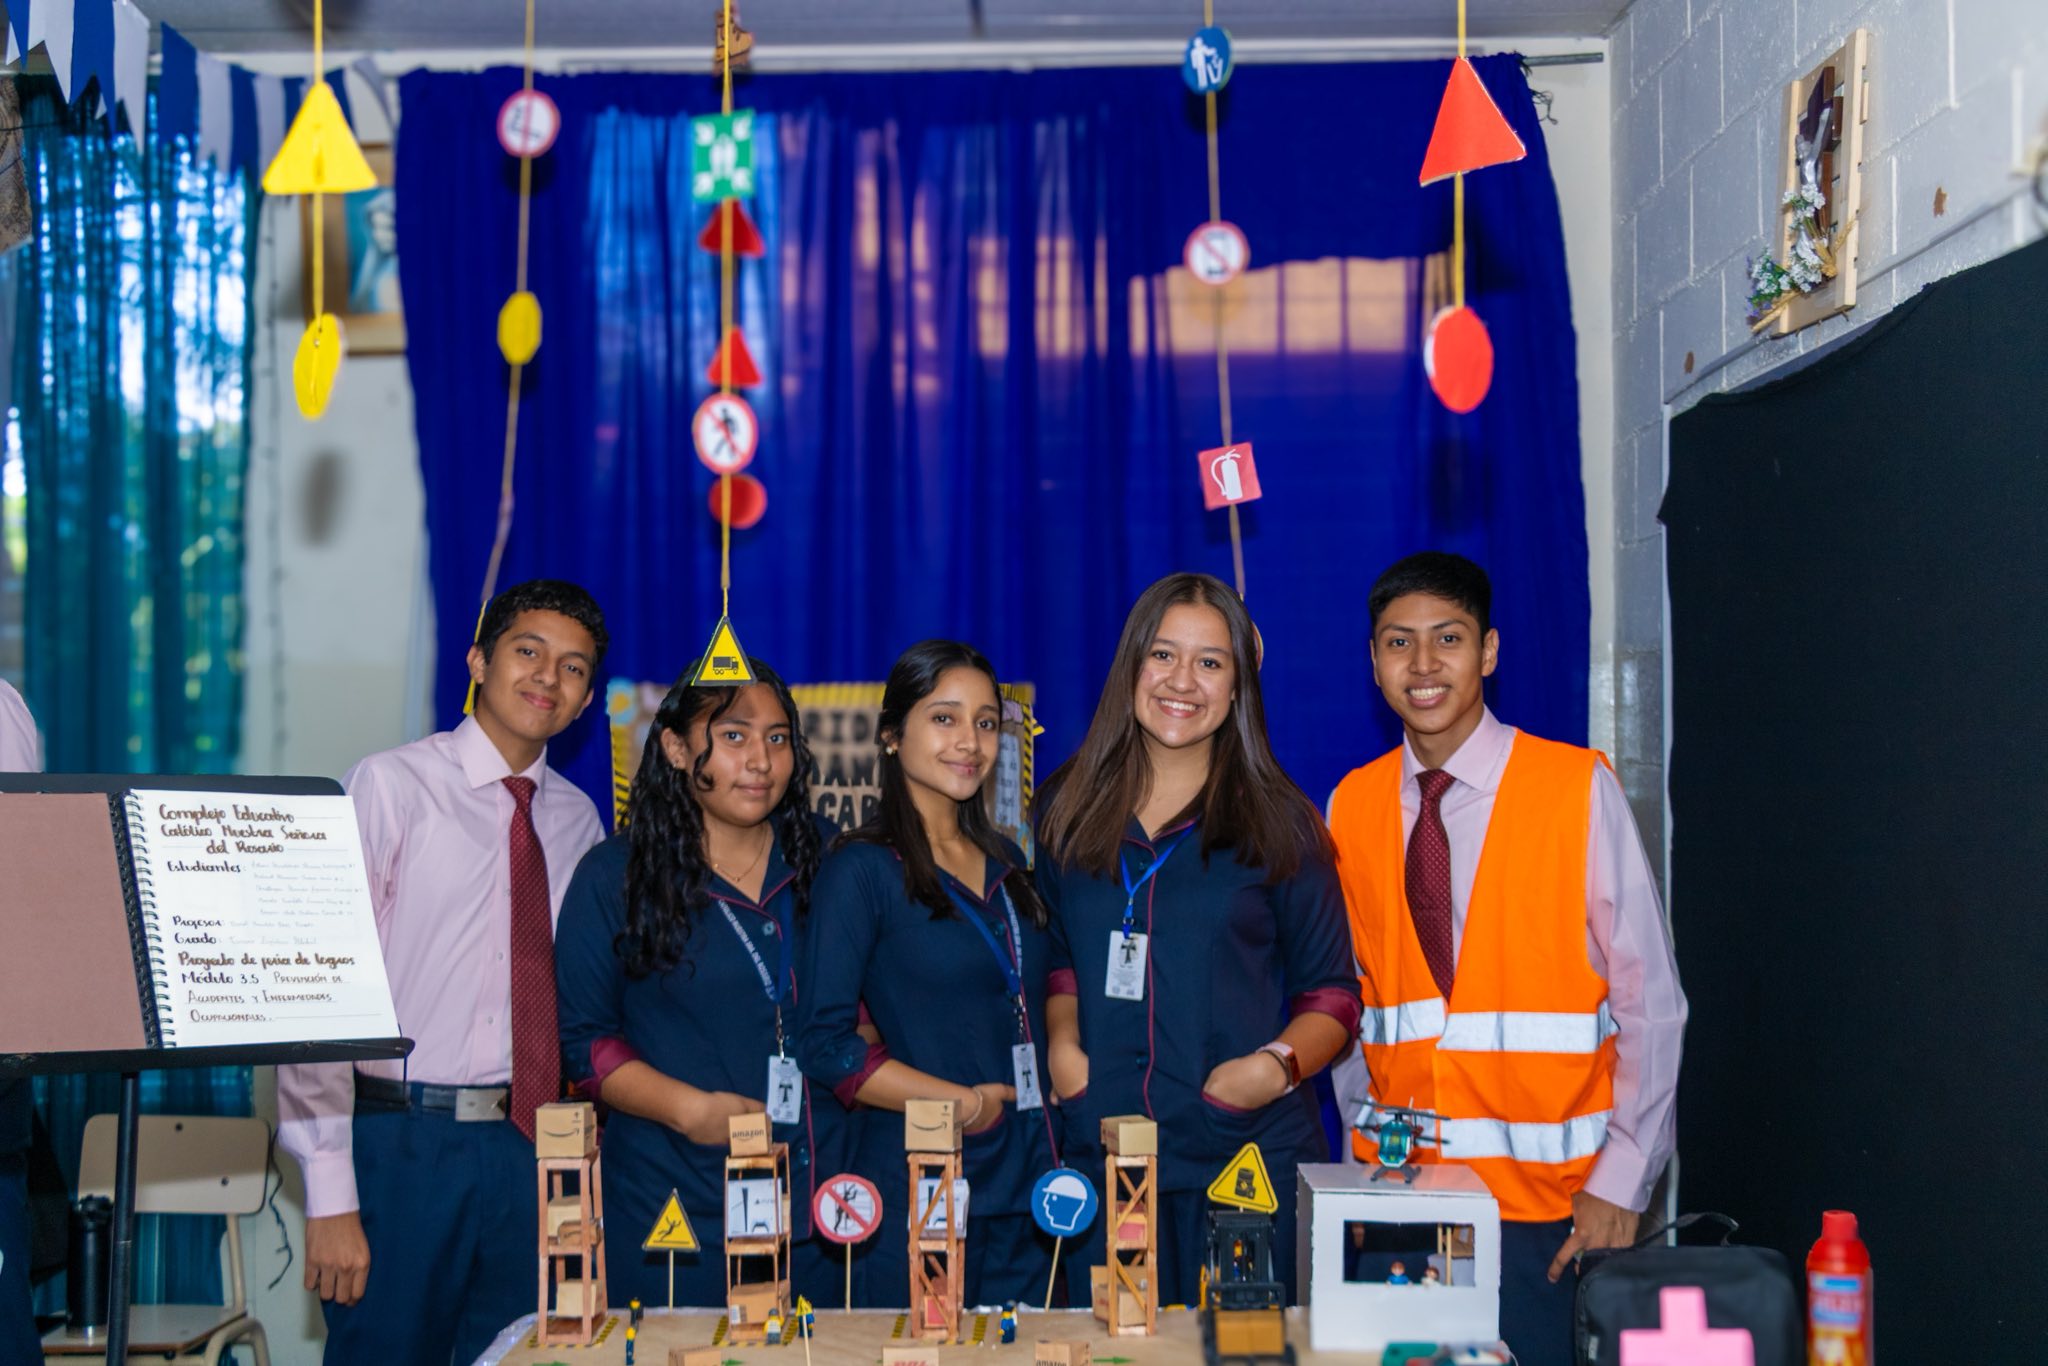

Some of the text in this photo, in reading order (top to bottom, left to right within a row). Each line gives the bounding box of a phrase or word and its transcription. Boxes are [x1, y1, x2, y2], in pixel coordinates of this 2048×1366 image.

[159, 803, 295, 826] Complejo Educativo
[161, 823, 327, 840] Católico Nuestra Señora
[206, 838, 284, 855] del Rosario
[177, 951, 355, 971] Proyecto de feria de logros
[181, 971, 234, 984] Módulo
[732, 1129, 764, 1141] amazon
